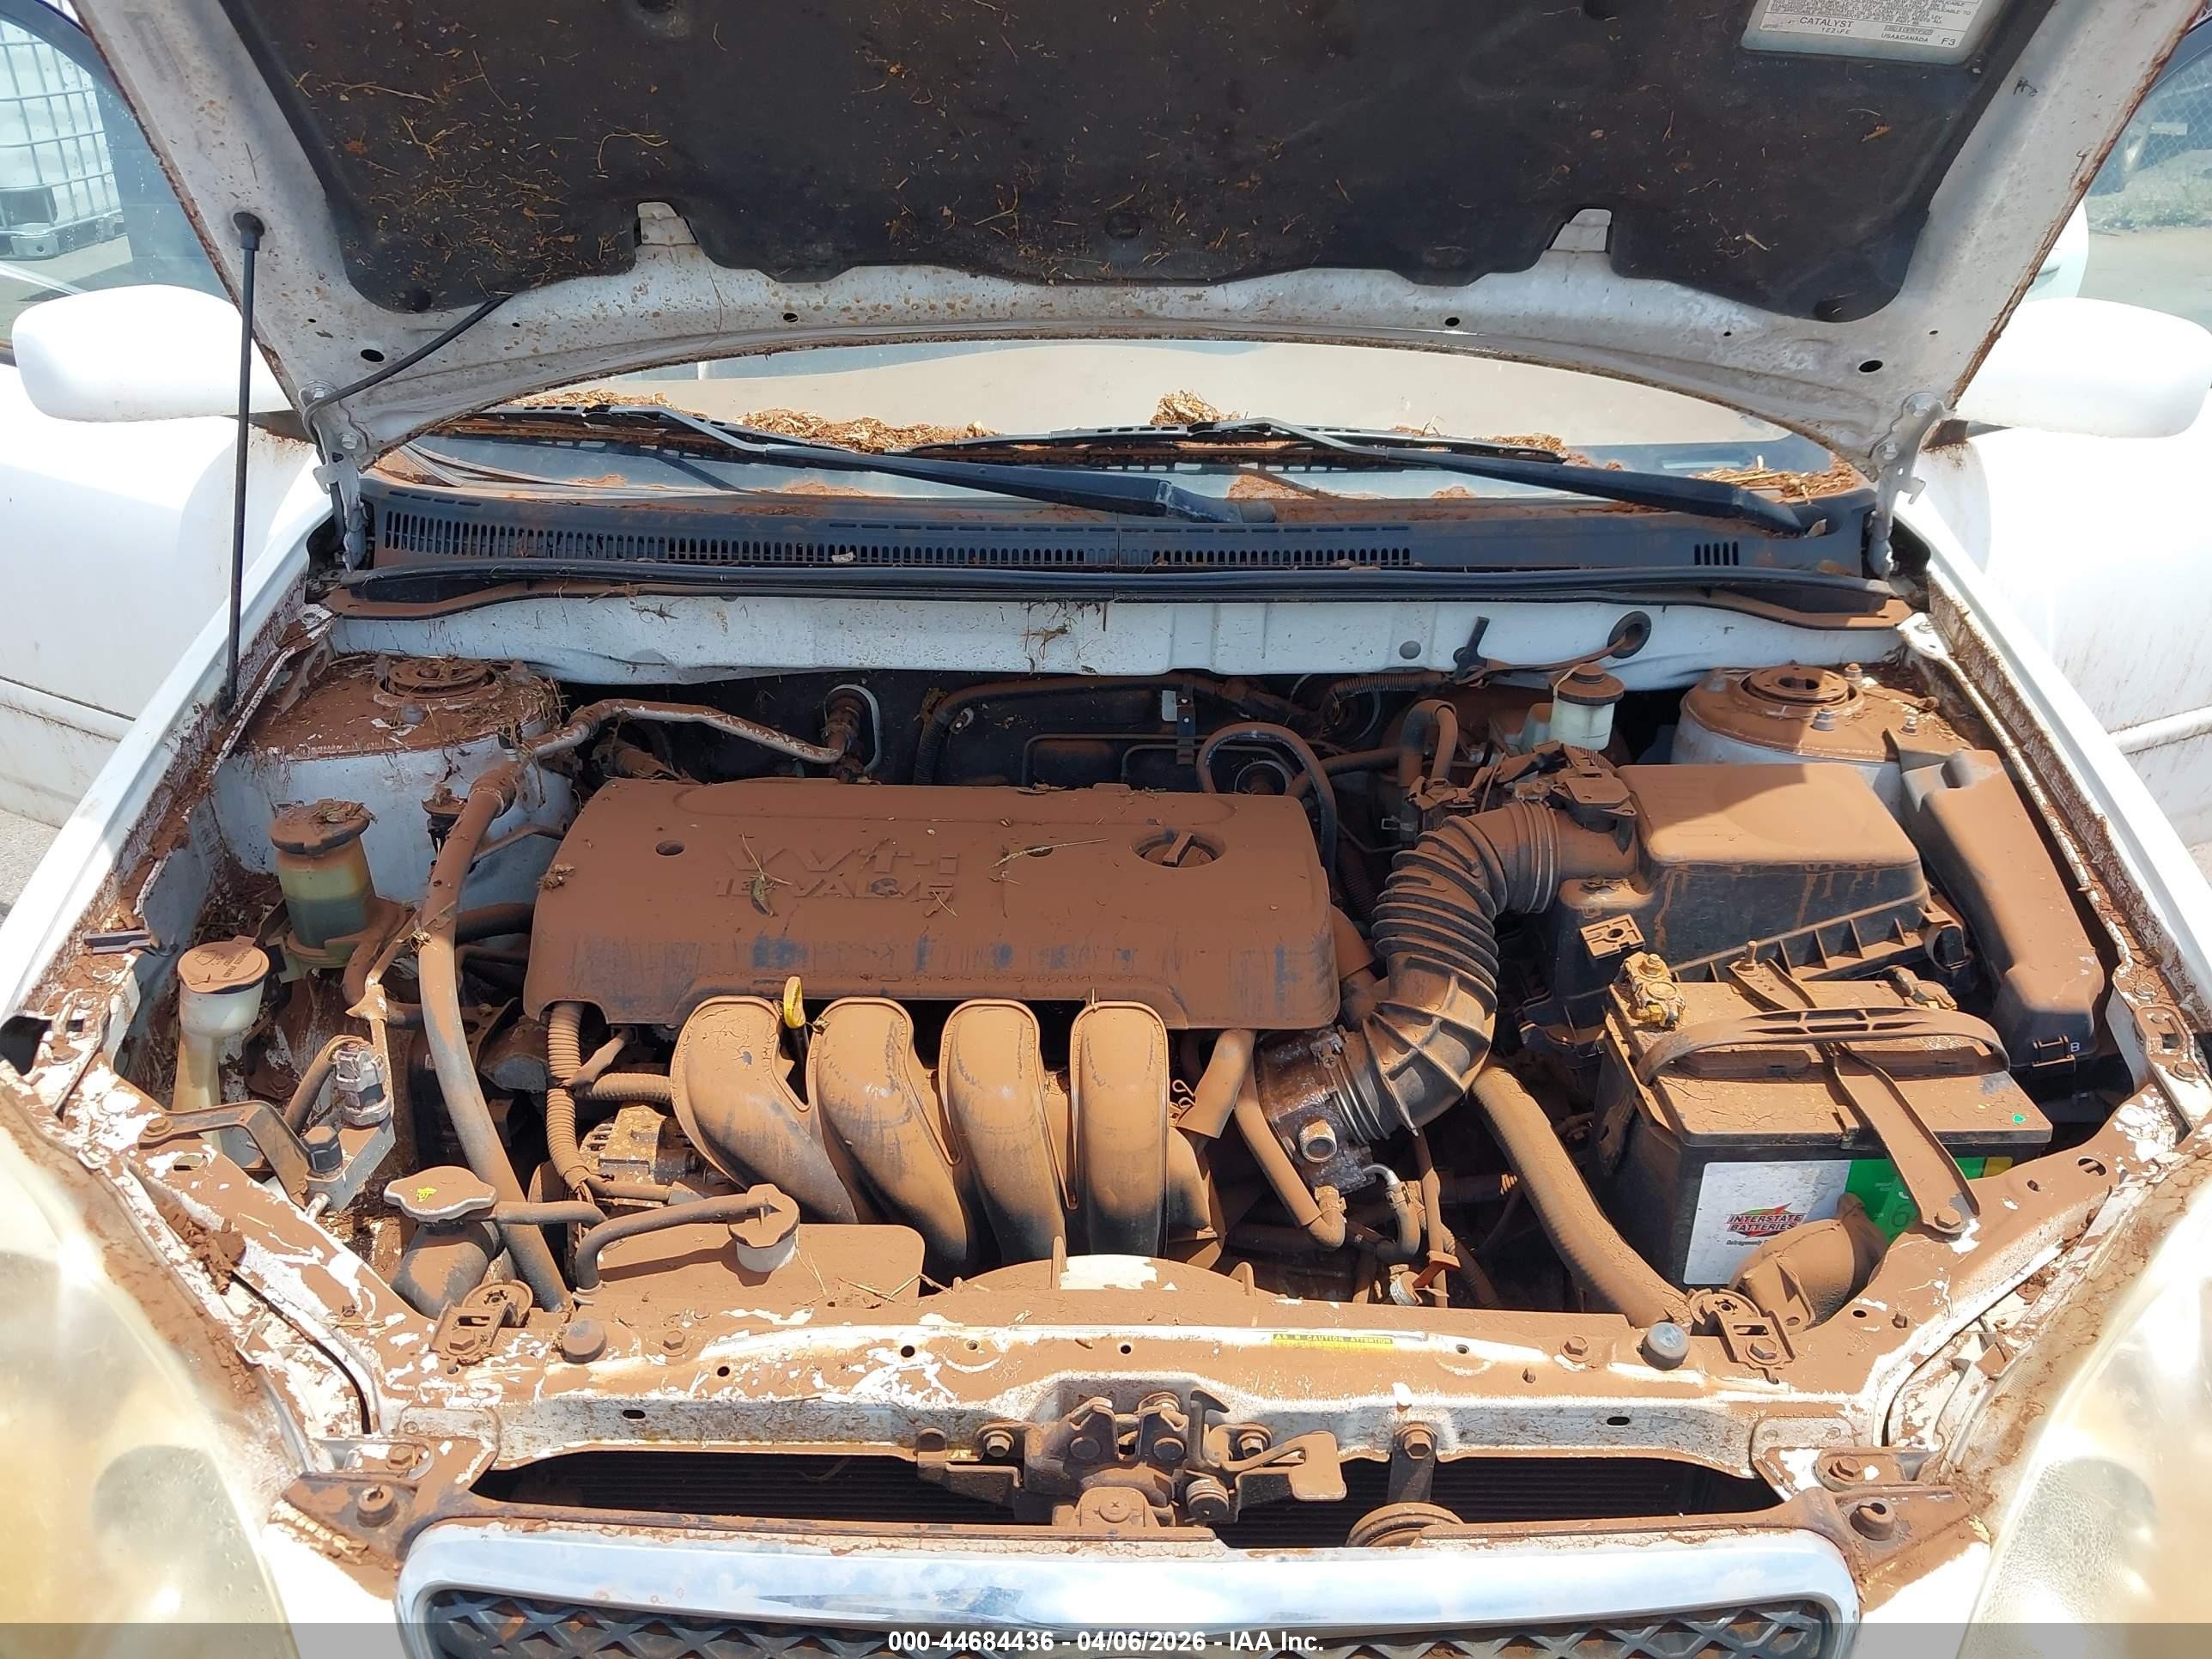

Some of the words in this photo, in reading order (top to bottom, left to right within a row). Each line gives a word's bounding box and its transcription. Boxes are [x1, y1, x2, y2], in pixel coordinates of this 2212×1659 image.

[1799, 16, 1854, 28] CATALYST
[1941, 37, 1956, 46] F3
[2070, 1042, 2080, 1052] B
